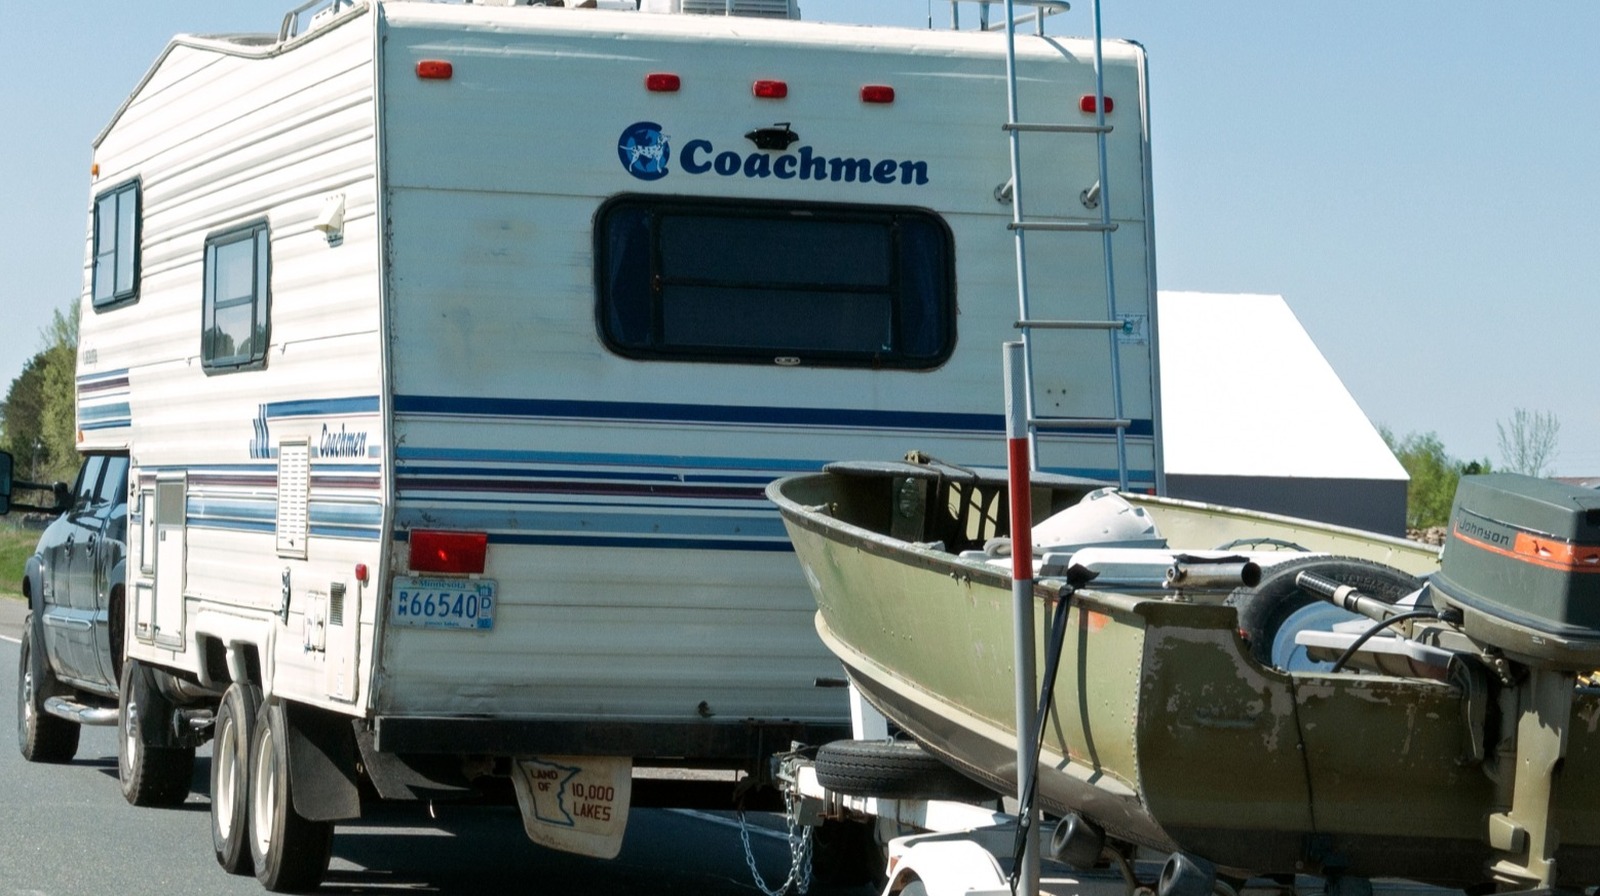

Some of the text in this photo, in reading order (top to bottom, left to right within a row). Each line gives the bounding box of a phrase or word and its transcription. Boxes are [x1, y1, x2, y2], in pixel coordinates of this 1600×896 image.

[680, 139, 929, 185] Coachmen
[319, 422, 367, 458] Coachmen
[1459, 518, 1510, 545] Johnson
[418, 580, 466, 589] Minnesota
[410, 592, 477, 619] 66540
[530, 769, 558, 780] LAND
[538, 782, 551, 792] OF
[572, 783, 615, 802] 10,000
[573, 802, 612, 822] LAKES
